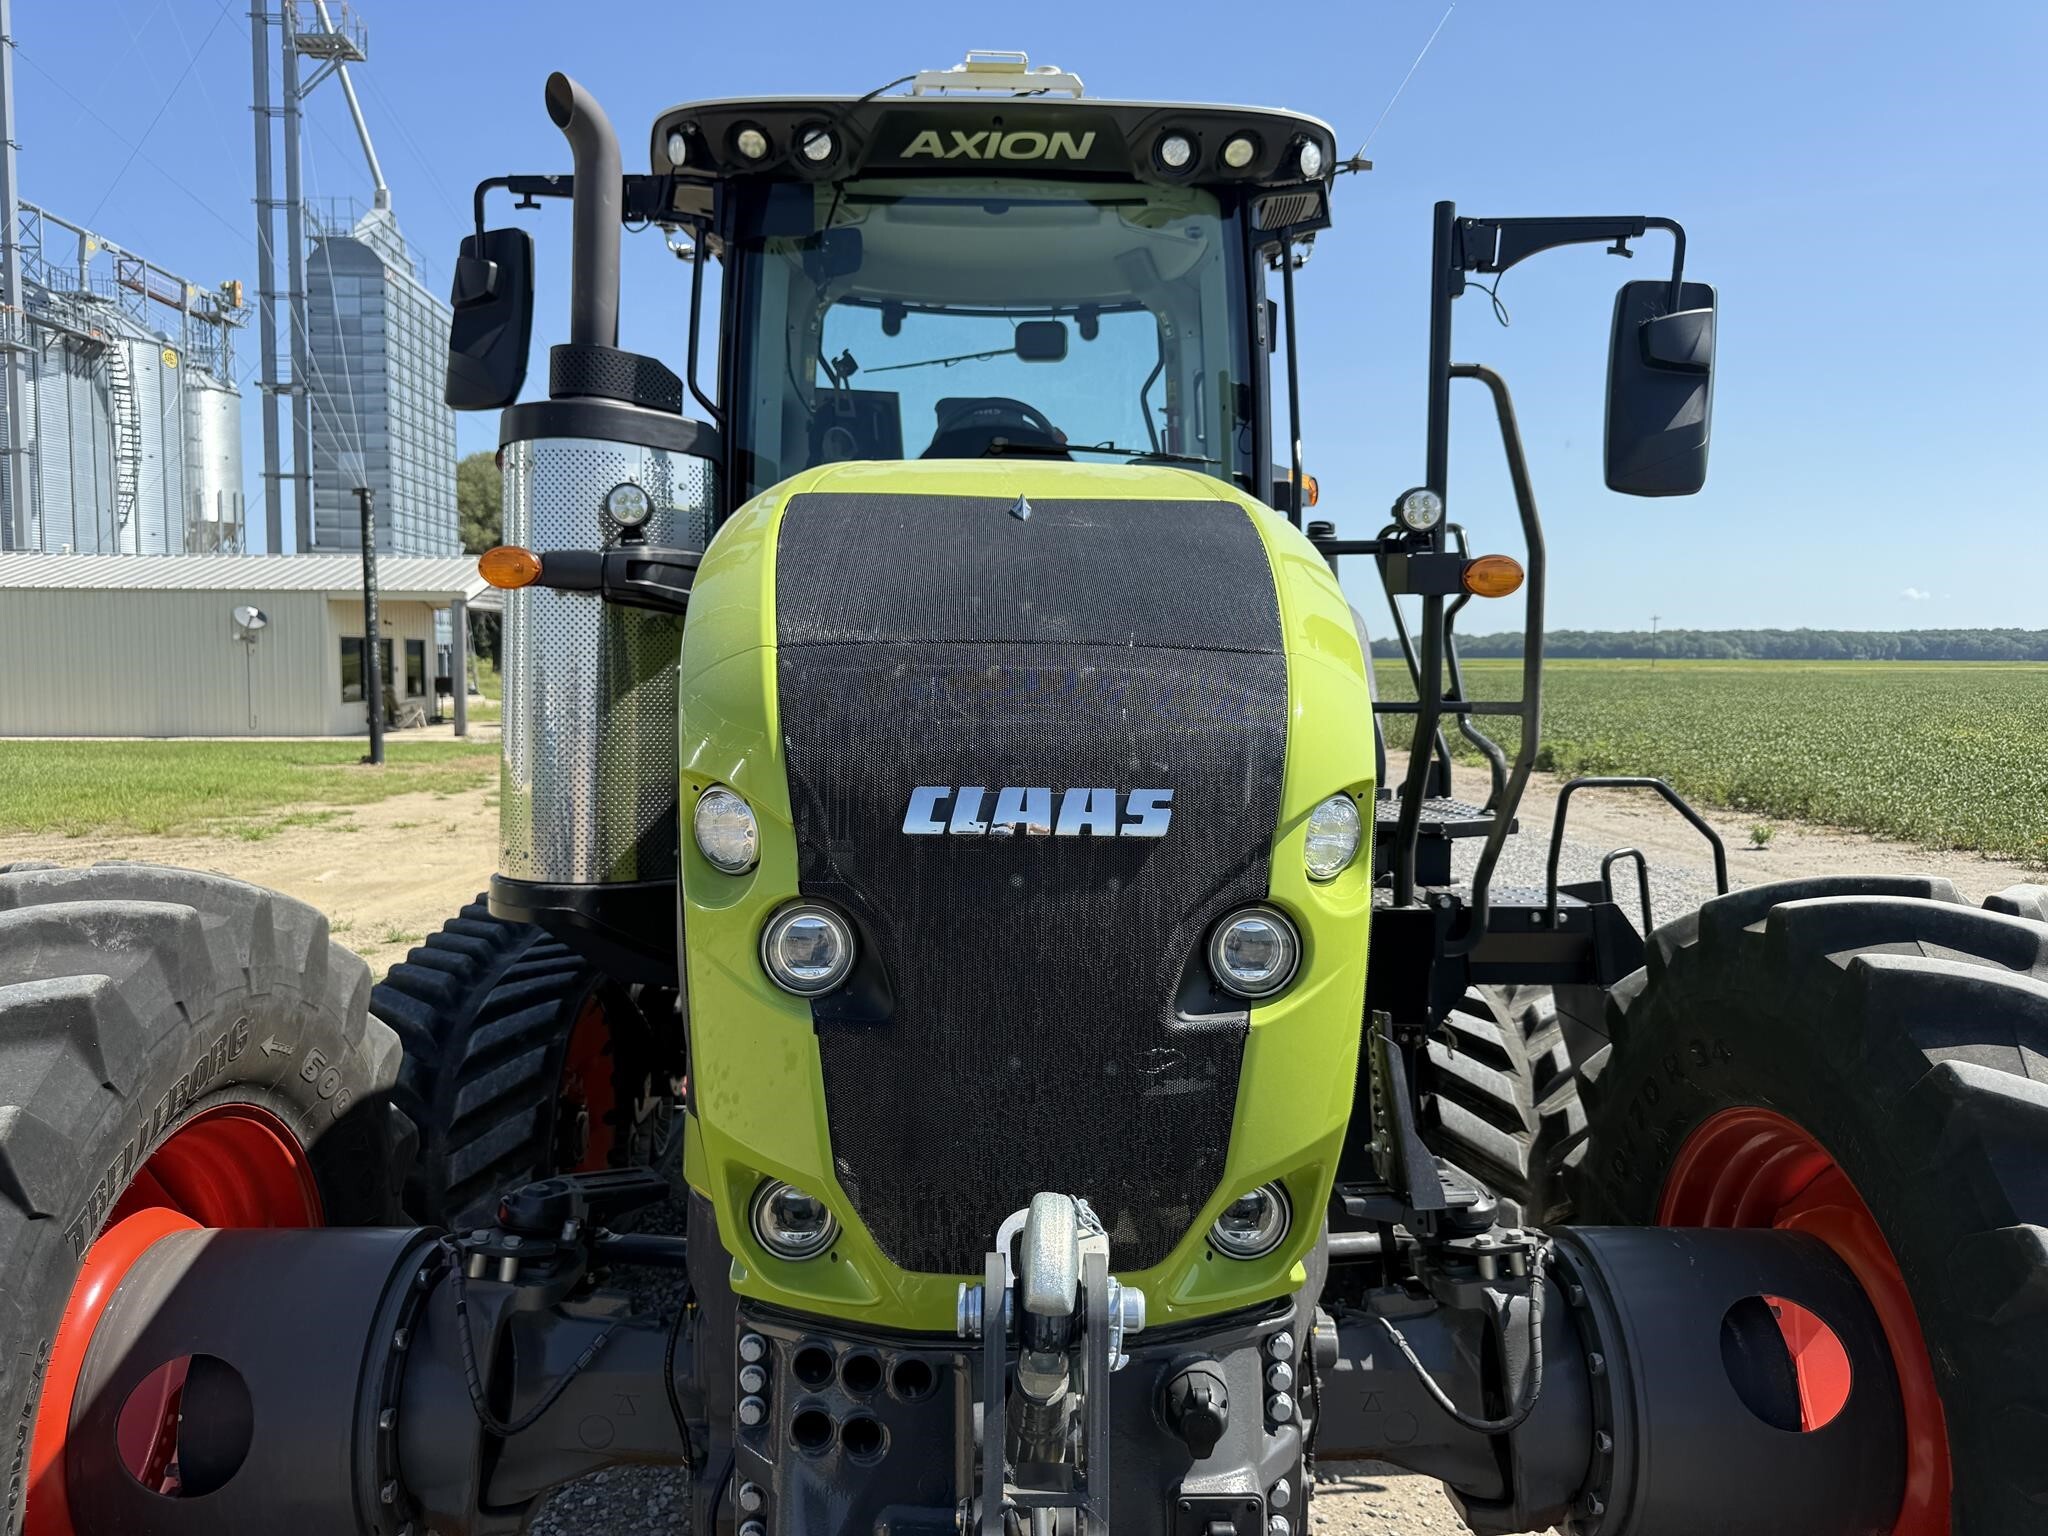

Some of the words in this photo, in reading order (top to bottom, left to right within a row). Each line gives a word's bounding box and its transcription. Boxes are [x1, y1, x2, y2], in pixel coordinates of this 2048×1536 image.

[900, 130, 1096, 160] AXION
[902, 786, 1174, 837] CLAAS
[64, 1016, 249, 1262] TRELLEBORG
